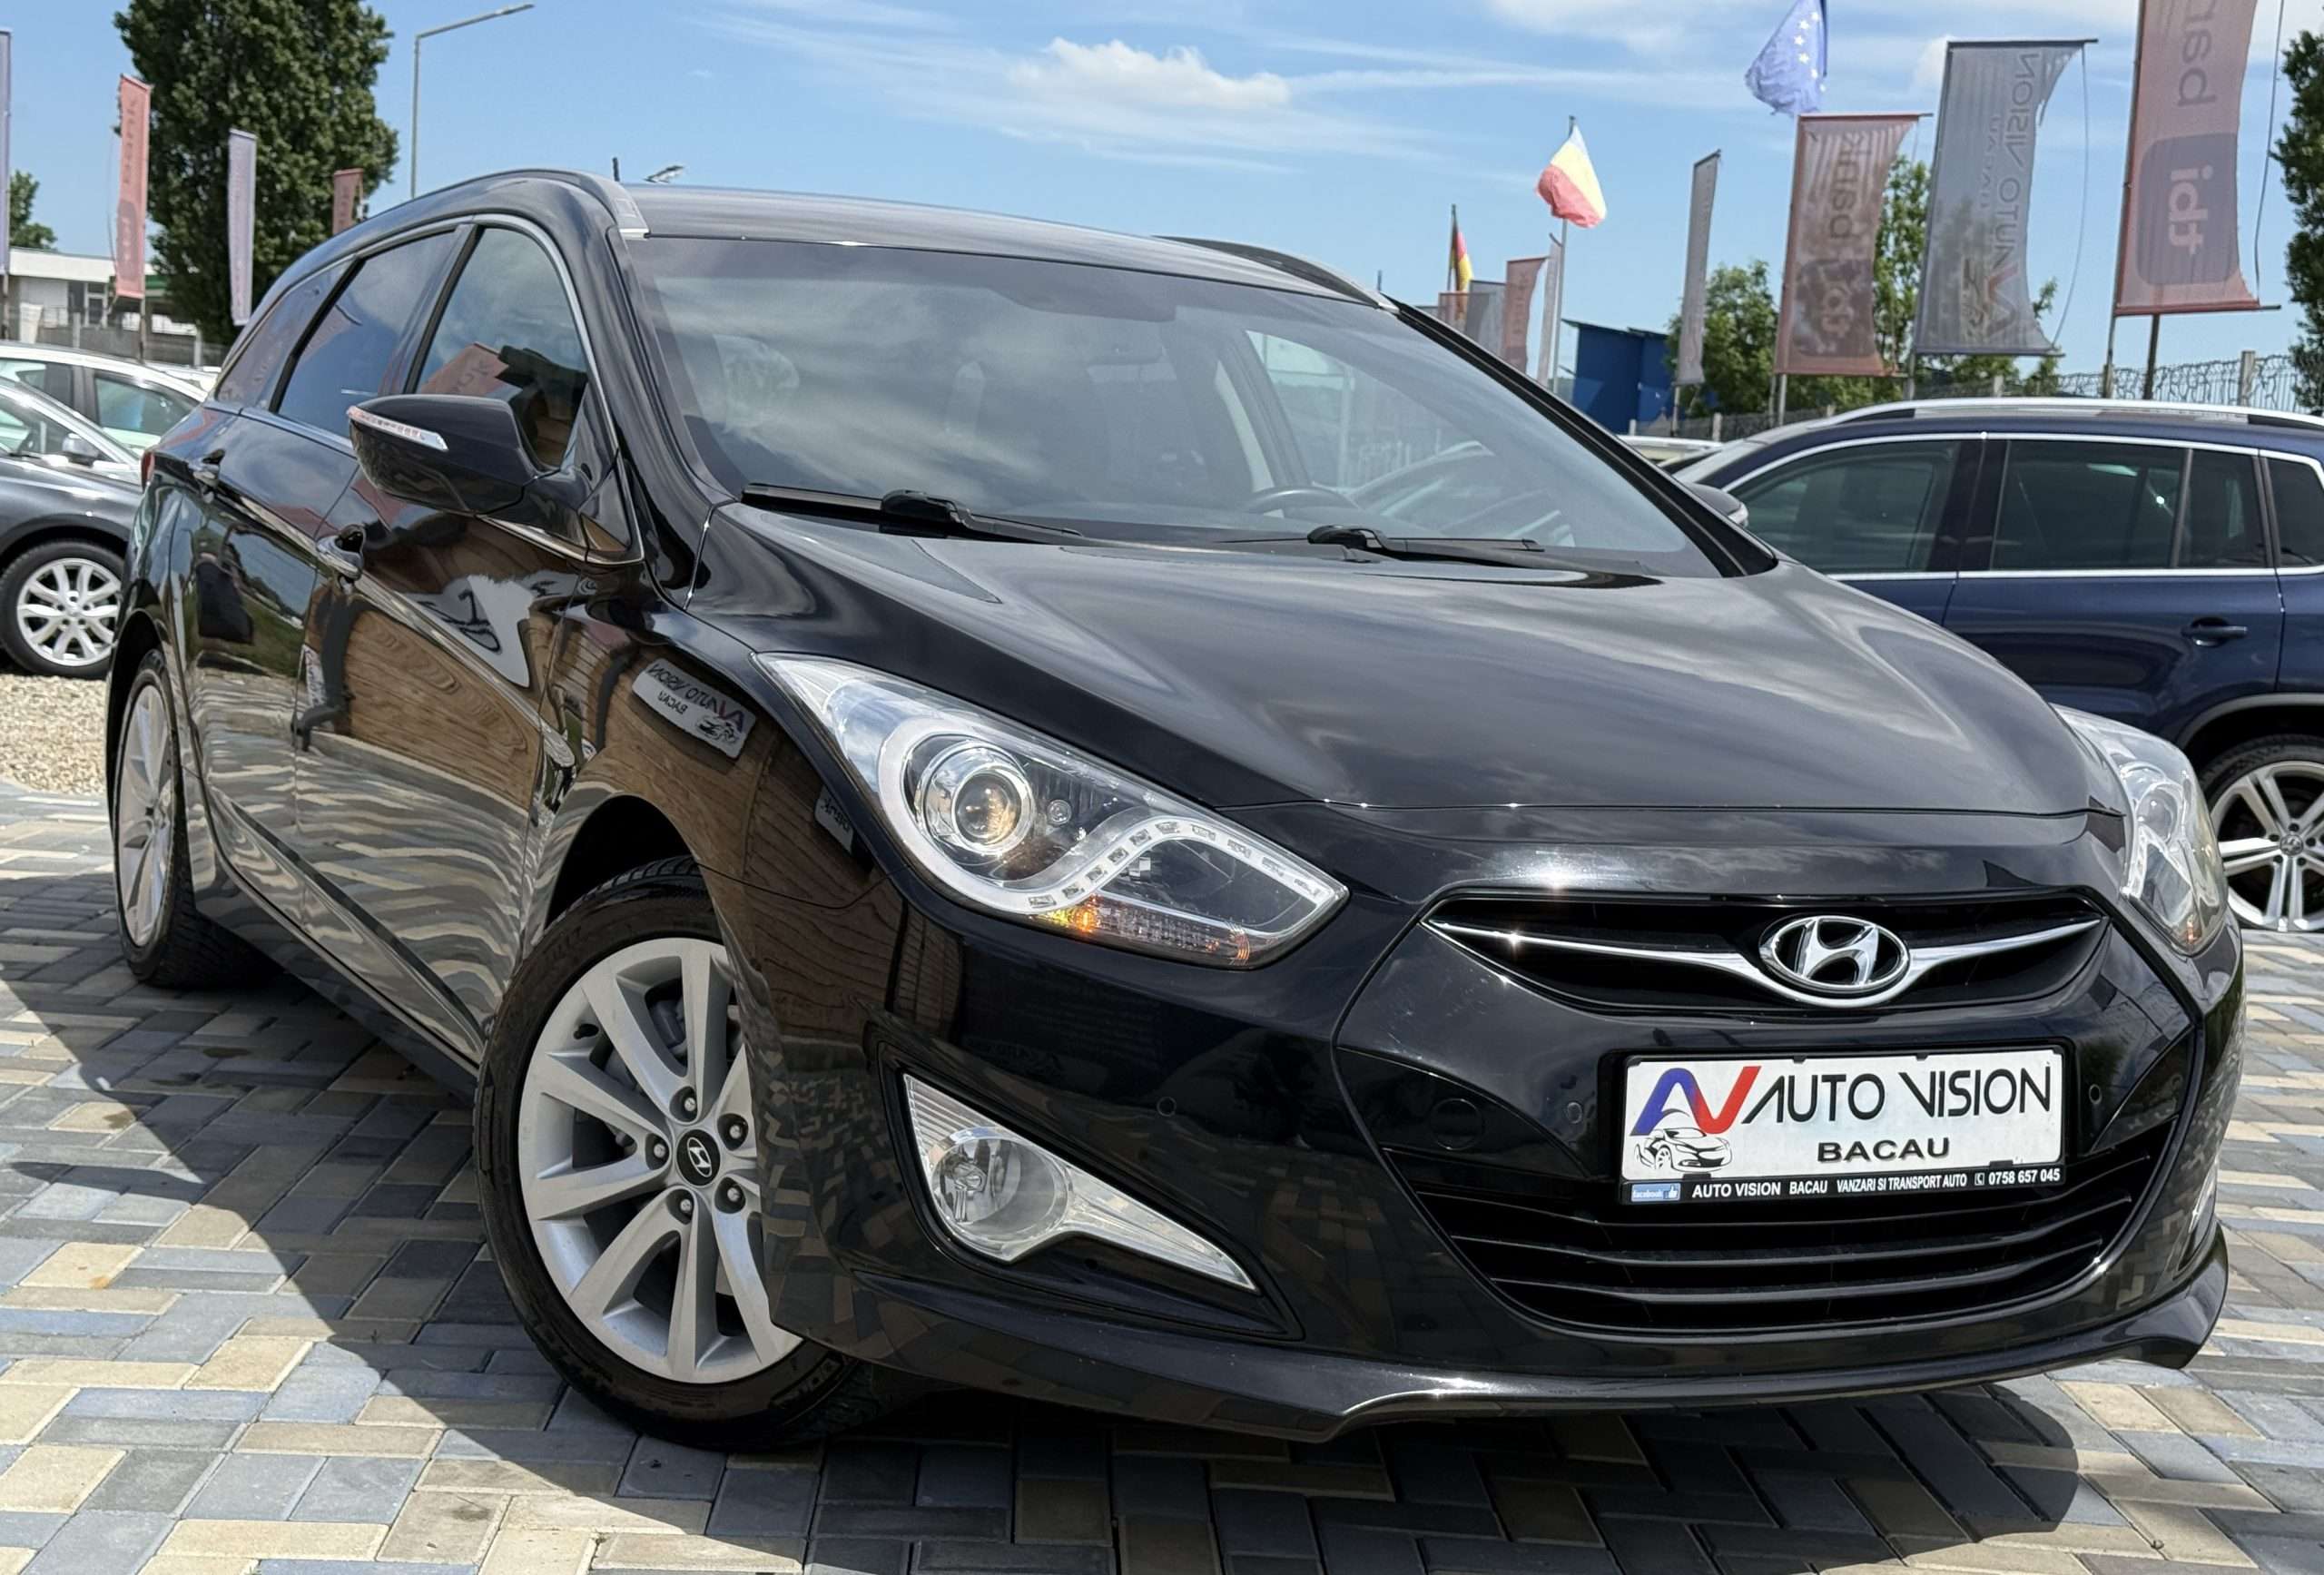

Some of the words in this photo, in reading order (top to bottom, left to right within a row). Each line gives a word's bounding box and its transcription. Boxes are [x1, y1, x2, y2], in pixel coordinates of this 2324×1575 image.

[1741, 1073, 1886, 1125] AUTO
[1898, 1066, 2052, 1118] VISION
[1817, 1137, 1951, 1163] BACAU
[1691, 1184, 1732, 1198] AUTO
[1735, 1181, 1781, 1197] VISION
[1789, 1180, 1828, 1196] BACAU
[1837, 1177, 1876, 1193] VANZARI
[1876, 1177, 1886, 1192] SI
[1887, 1175, 1942, 1191] TRANSPORT
[1942, 1173, 1967, 1188] AUTO
[1988, 1170, 2015, 1186] 0758
[2017, 1168, 2037, 1184] 657
[2040, 1167, 2061, 1183] 045
